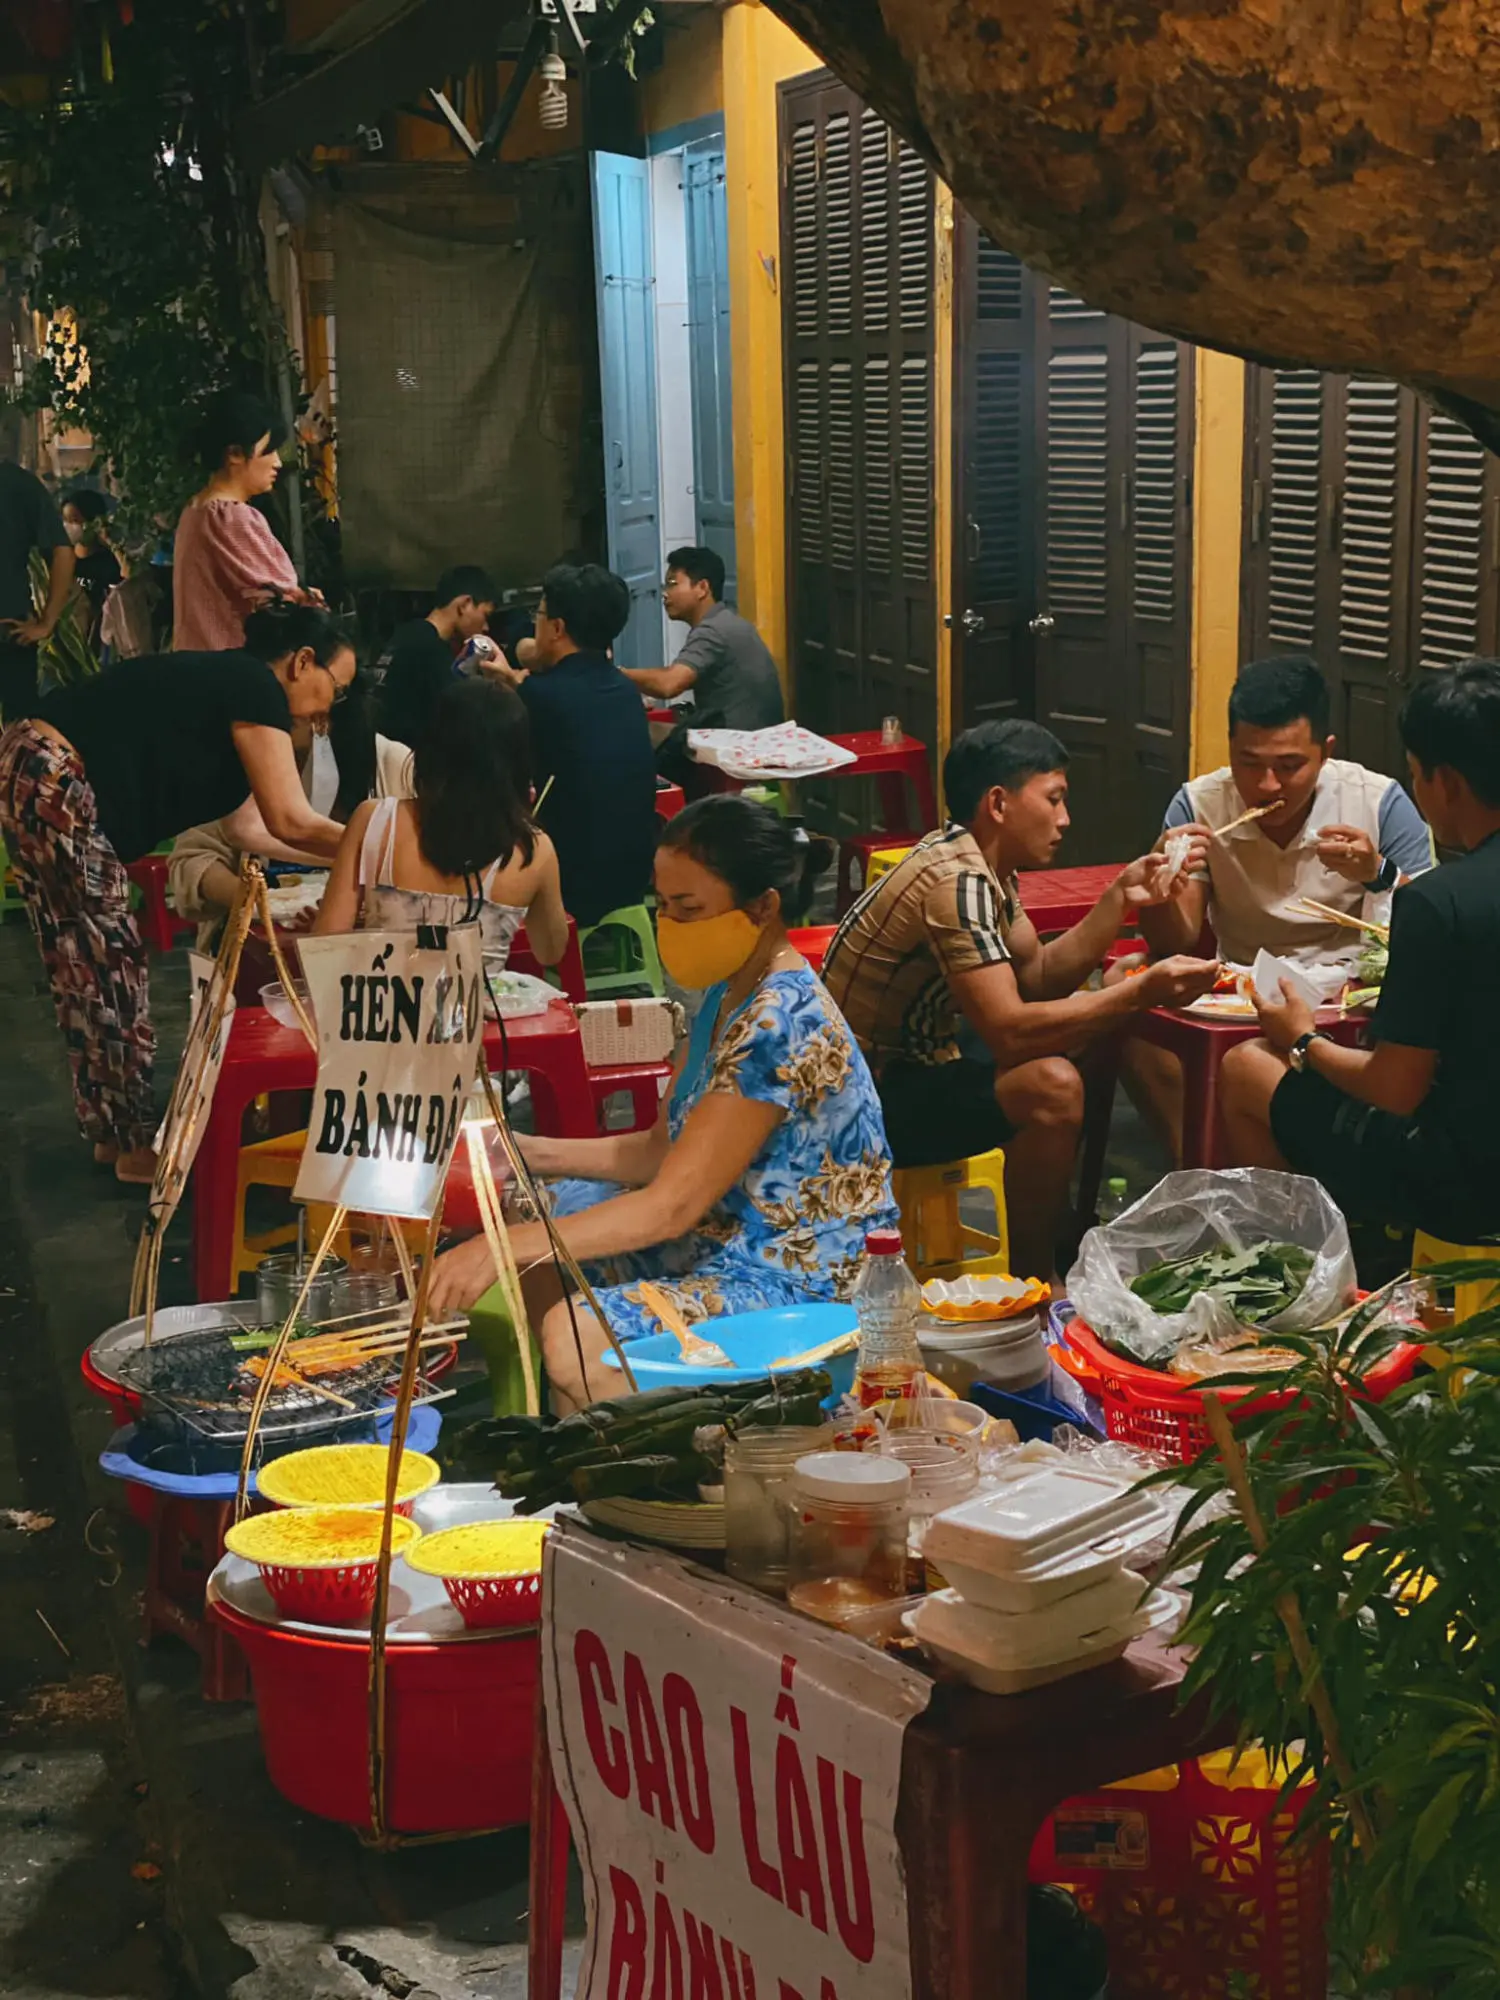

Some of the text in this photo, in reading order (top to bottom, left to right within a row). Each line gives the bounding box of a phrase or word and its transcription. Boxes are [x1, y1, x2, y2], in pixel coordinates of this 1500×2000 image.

[340, 943, 424, 1044] HẾN
[316, 1071, 421, 1163] BÁNH
[574, 1629, 715, 1855] CAO
